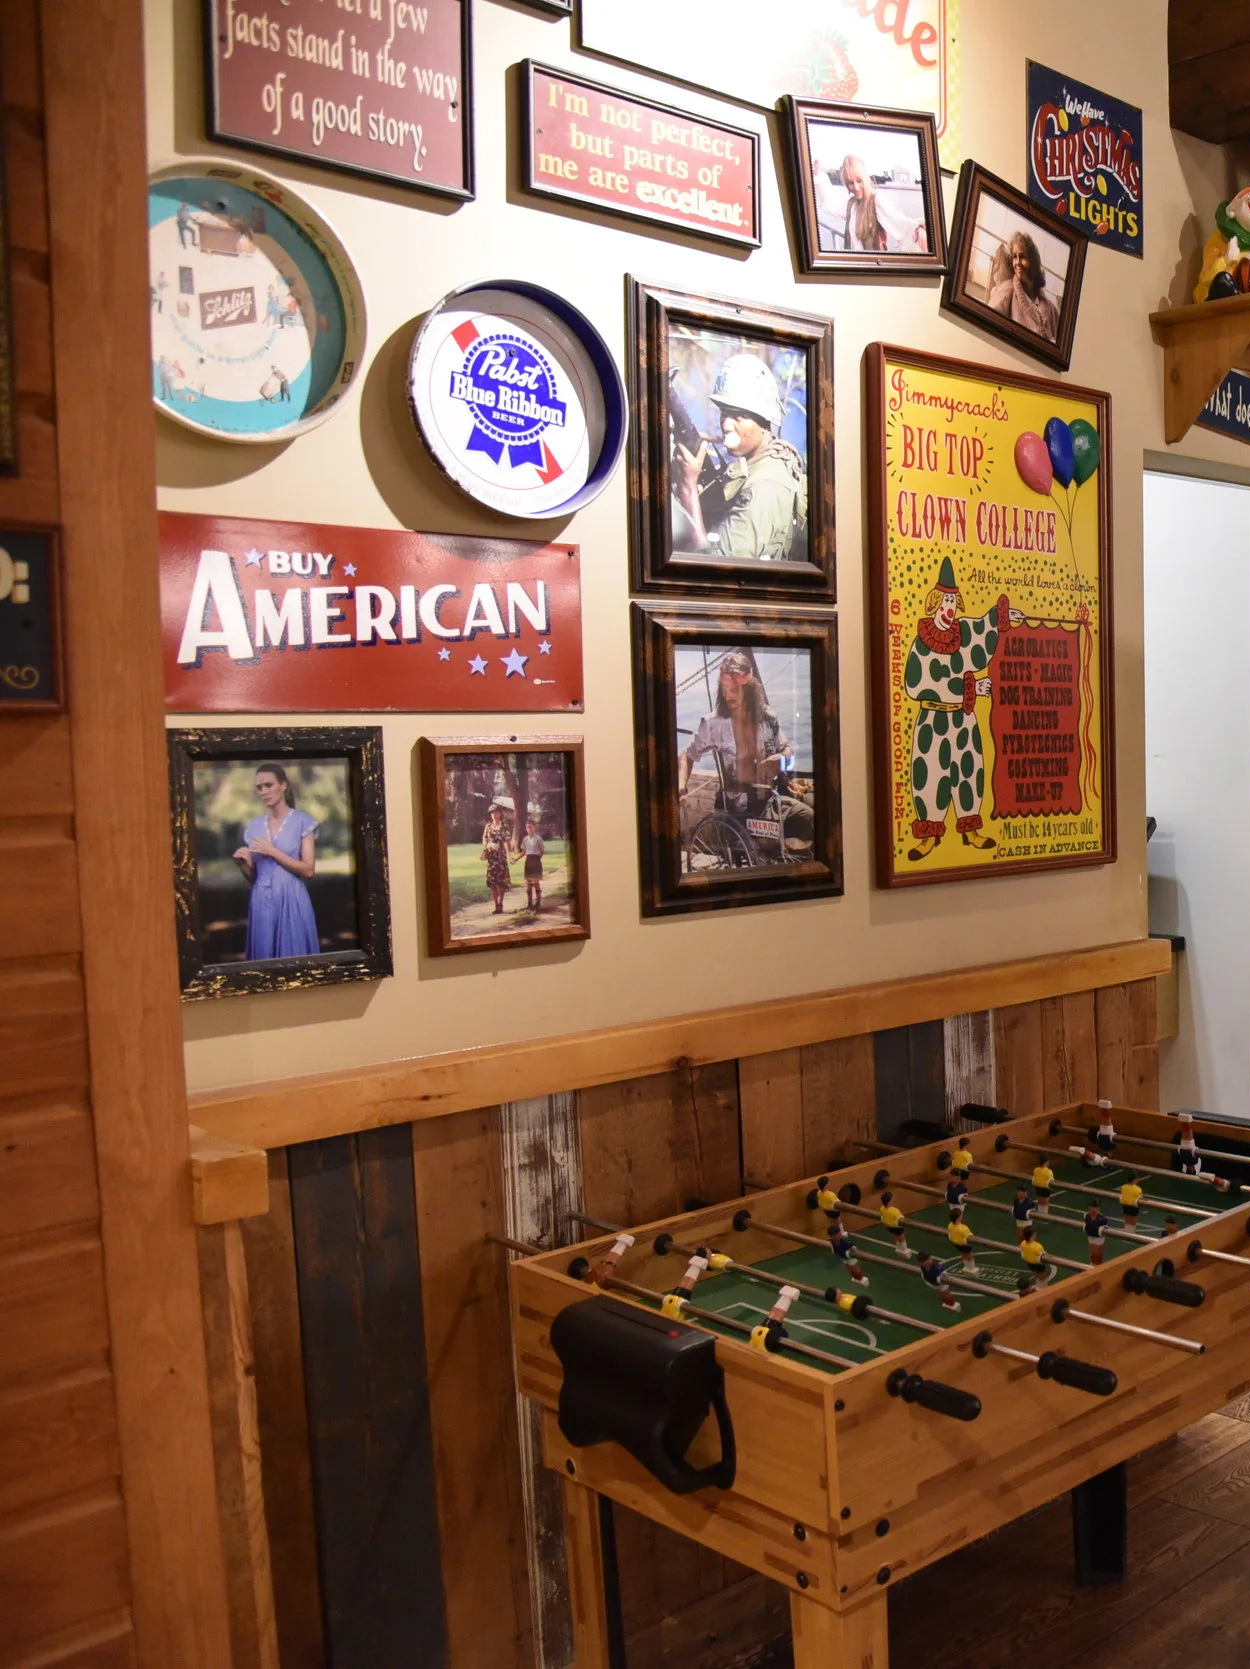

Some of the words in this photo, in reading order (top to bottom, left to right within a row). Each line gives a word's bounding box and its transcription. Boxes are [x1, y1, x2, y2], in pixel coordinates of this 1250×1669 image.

[386, 0, 428, 46] few
[223, 0, 281, 59] facts
[287, 24, 344, 71] stand
[350, 36, 371, 79] in
[376, 40, 407, 89] the
[413, 66, 458, 123] way
[262, 72, 287, 136] of
[291, 91, 304, 121] a
[312, 95, 363, 146] good
[368, 107, 428, 172] story.
[547, 82, 589, 117] I'm
[600, 99, 643, 133] not
[651, 118, 741, 166] perfect,
[1065, 94, 1082, 116] We
[1081, 101, 1105, 121] Have
[569, 122, 615, 159] but
[623, 144, 689, 180] parts
[698, 164, 723, 189] of
[1031, 102, 1142, 203] CHRISTMAS
[538, 152, 579, 180] me
[588, 165, 630, 194] are
[635, 180, 750, 227] excellent.
[1069, 191, 1139, 238] LIGHTS
[205, 290, 253, 325] Schlitz
[478, 344, 544, 391] Pabst
[451, 371, 496, 407] Blue
[497, 385, 564, 427] Ribbon
[888, 368, 1009, 423] Jimmycrack's
[492, 411, 525, 427] BEER
[901, 424, 938, 473] BIG
[944, 432, 984, 480] TOP
[896, 490, 967, 544] CLOWN
[976, 500, 1057, 554] COLLEGE
[268, 550, 335, 577] BUY
[988, 571, 1002, 585] the
[1004, 572, 1035, 587] world
[1036, 574, 1061, 590] loves
[177, 550, 549, 665] AMERICAN
[890, 599, 902, 616] 6
[889, 622, 904, 687] WEEKS
[1003, 636, 1069, 659] ACROBATICS
[999, 661, 1033, 682] SKITS
[1040, 663, 1073, 683] MAGIC
[892, 691, 902, 717] OF
[999, 685, 1021, 706] DOG
[1021, 685, 1074, 707] TRAINING
[1012, 709, 1060, 731] DANCING
[892, 721, 904, 773] GOOD
[1007, 756, 1069, 779] COSTUMING
[999, 845, 1031, 858] CASH
[1033, 843, 1047, 855] IN
[1048, 840, 1099, 854] ADVANCE
[1002, 821, 1027, 840] Must
[1029, 820, 1040, 838] be
[1042, 821, 1052, 837] 14
[1053, 820, 1078, 840] years
[1080, 818, 1093, 835] old
